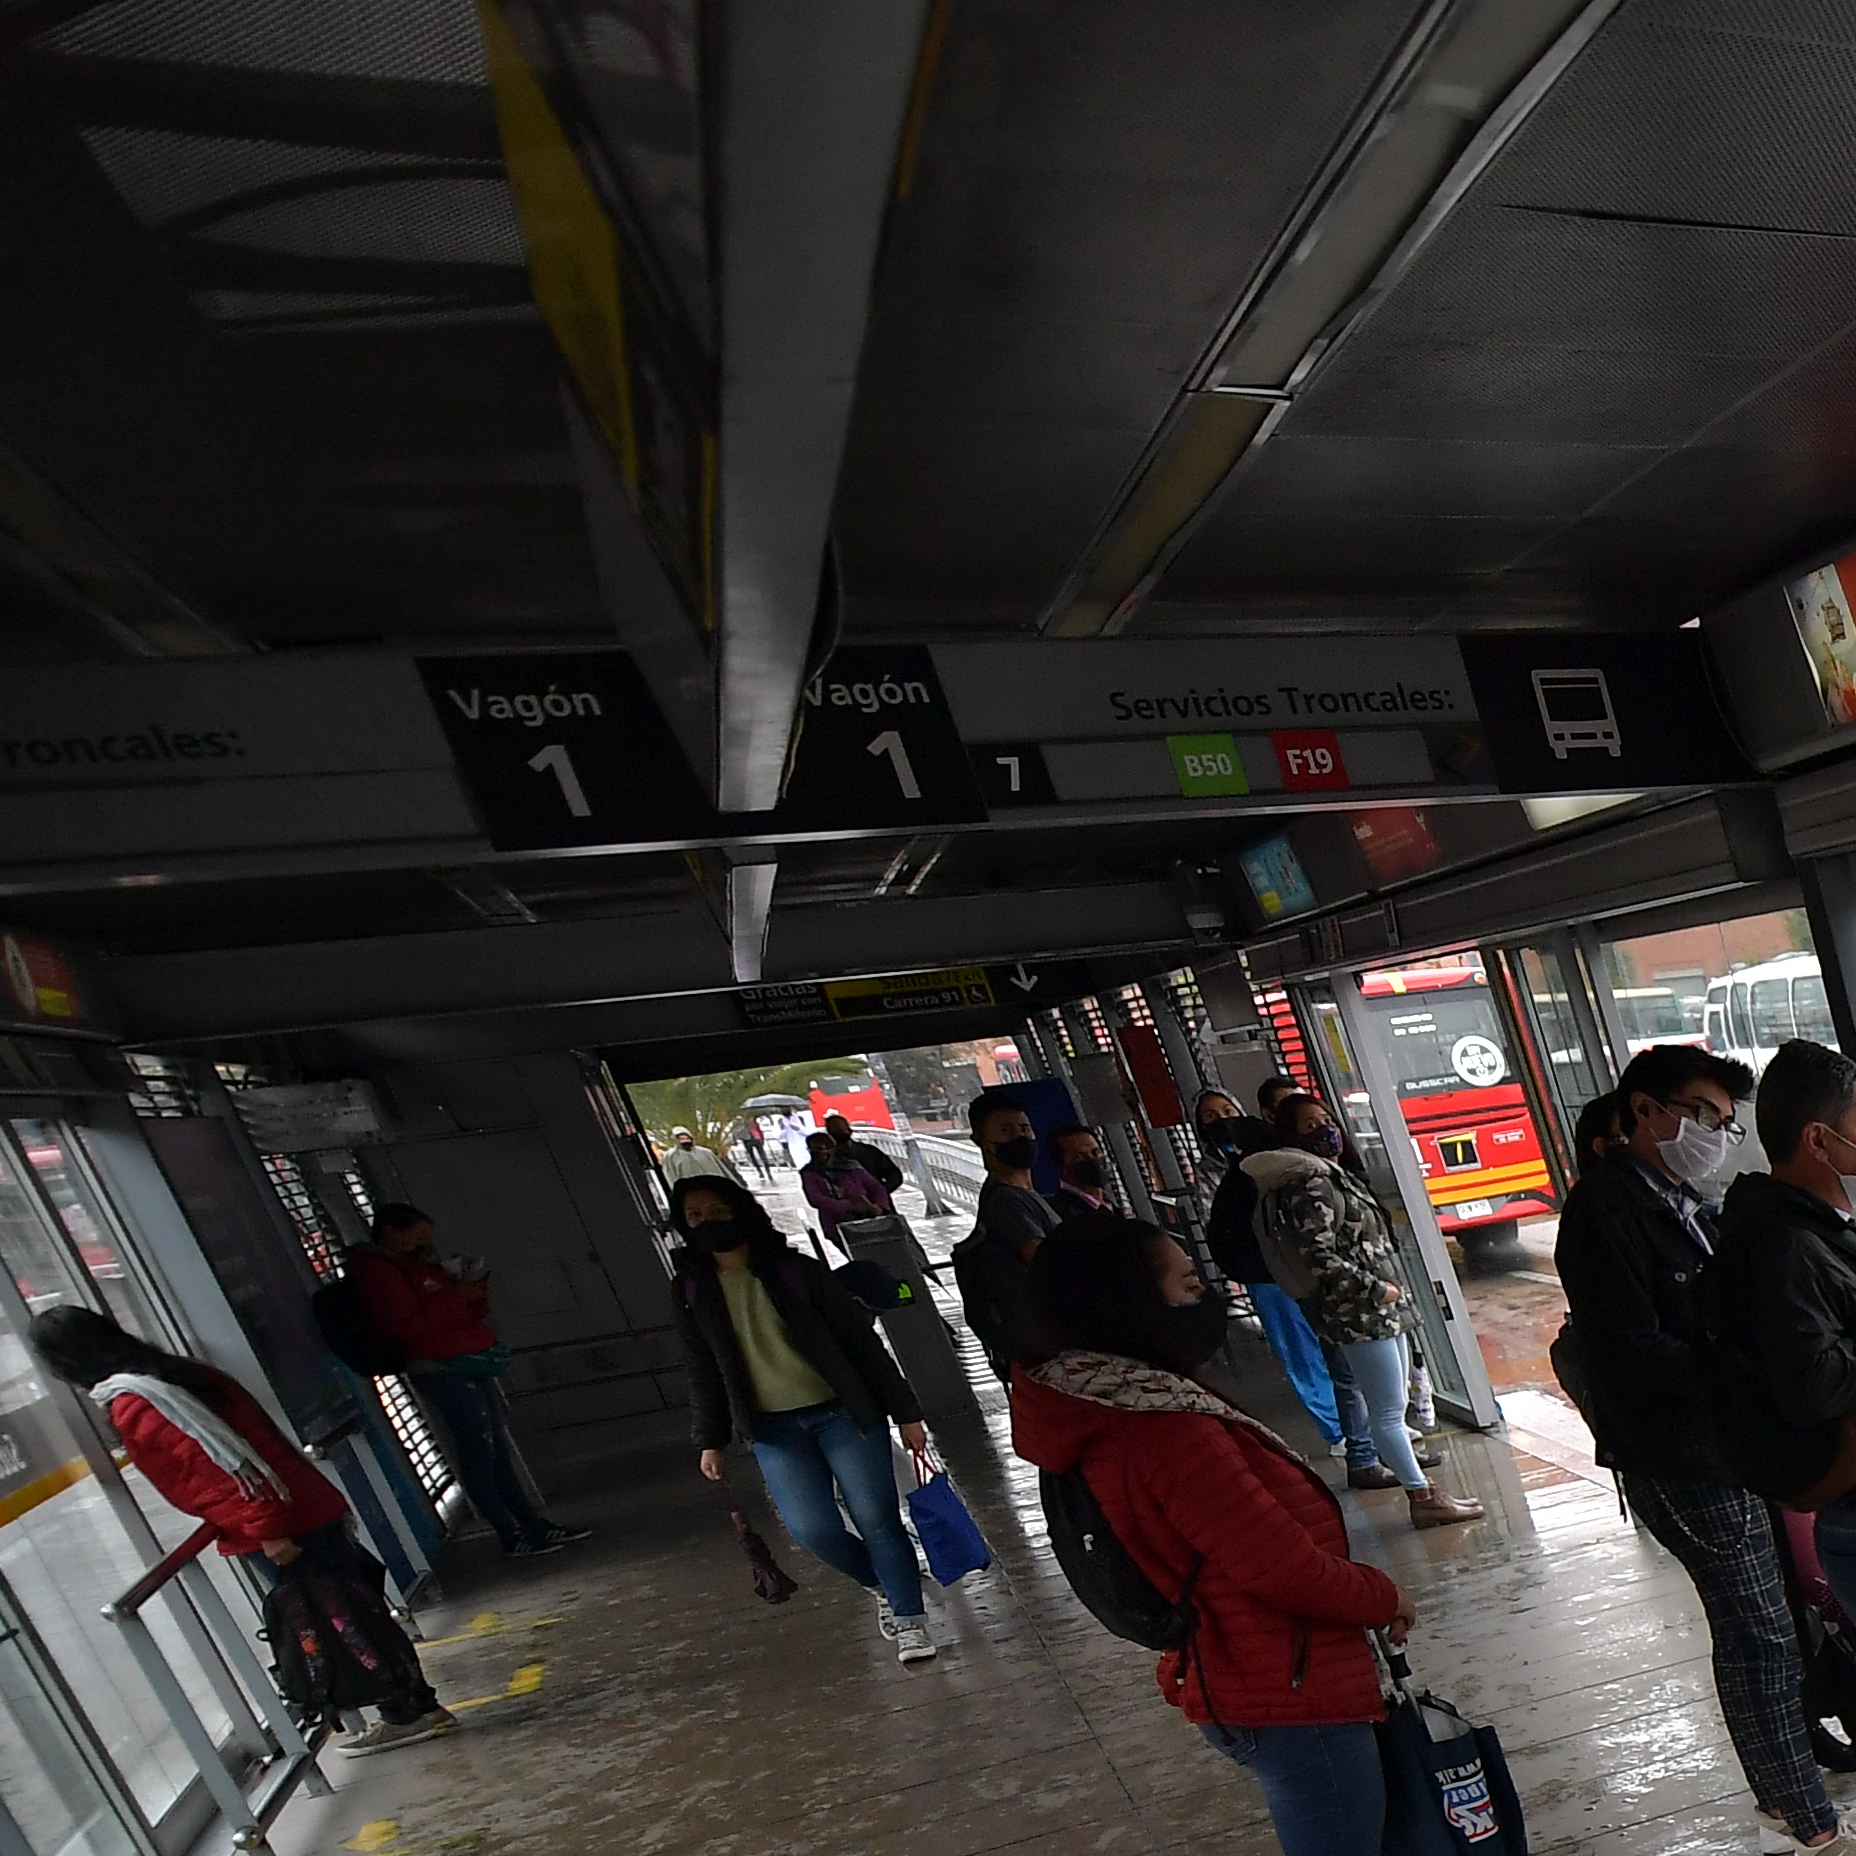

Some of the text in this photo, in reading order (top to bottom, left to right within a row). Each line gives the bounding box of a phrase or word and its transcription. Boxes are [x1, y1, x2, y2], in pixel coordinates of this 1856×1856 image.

[446, 684, 603, 727] Vagón
[804, 674, 932, 714] Vagón
[1108, 681, 1456, 720] Servicios Troncales:
[0, 723, 243, 766] roncales:
[865, 730, 922, 798] 1
[1287, 747, 1334, 776] F19
[527, 744, 592, 817] 1
[996, 756, 1021, 792] 7
[1183, 753, 1233, 777] B50
[738, 983, 818, 1002] Gracias
[883, 989, 960, 1010] Carrera 91
